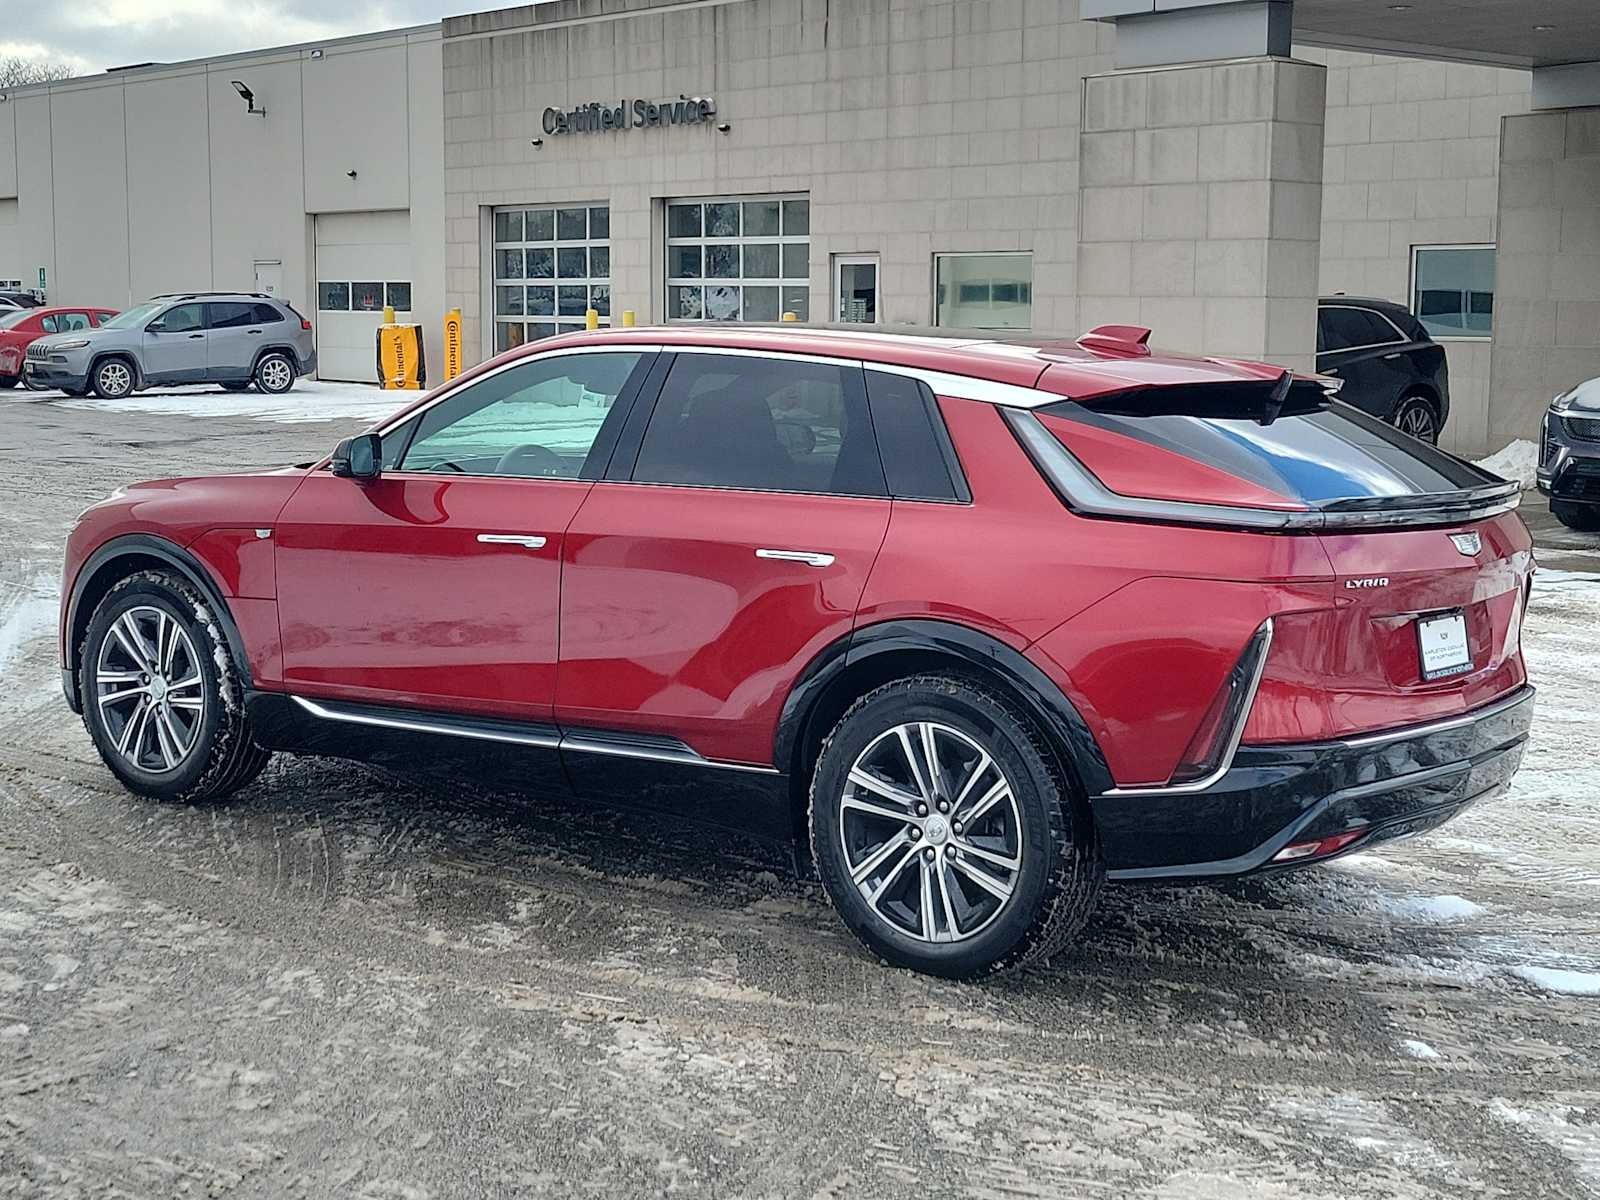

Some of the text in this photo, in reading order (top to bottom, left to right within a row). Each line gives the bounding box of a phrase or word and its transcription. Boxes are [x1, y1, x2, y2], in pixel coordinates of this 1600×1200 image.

[542, 98, 714, 136] Certified Service
[394, 342, 406, 388] Cotinental
[1345, 577, 1389, 589] LYRIQ
